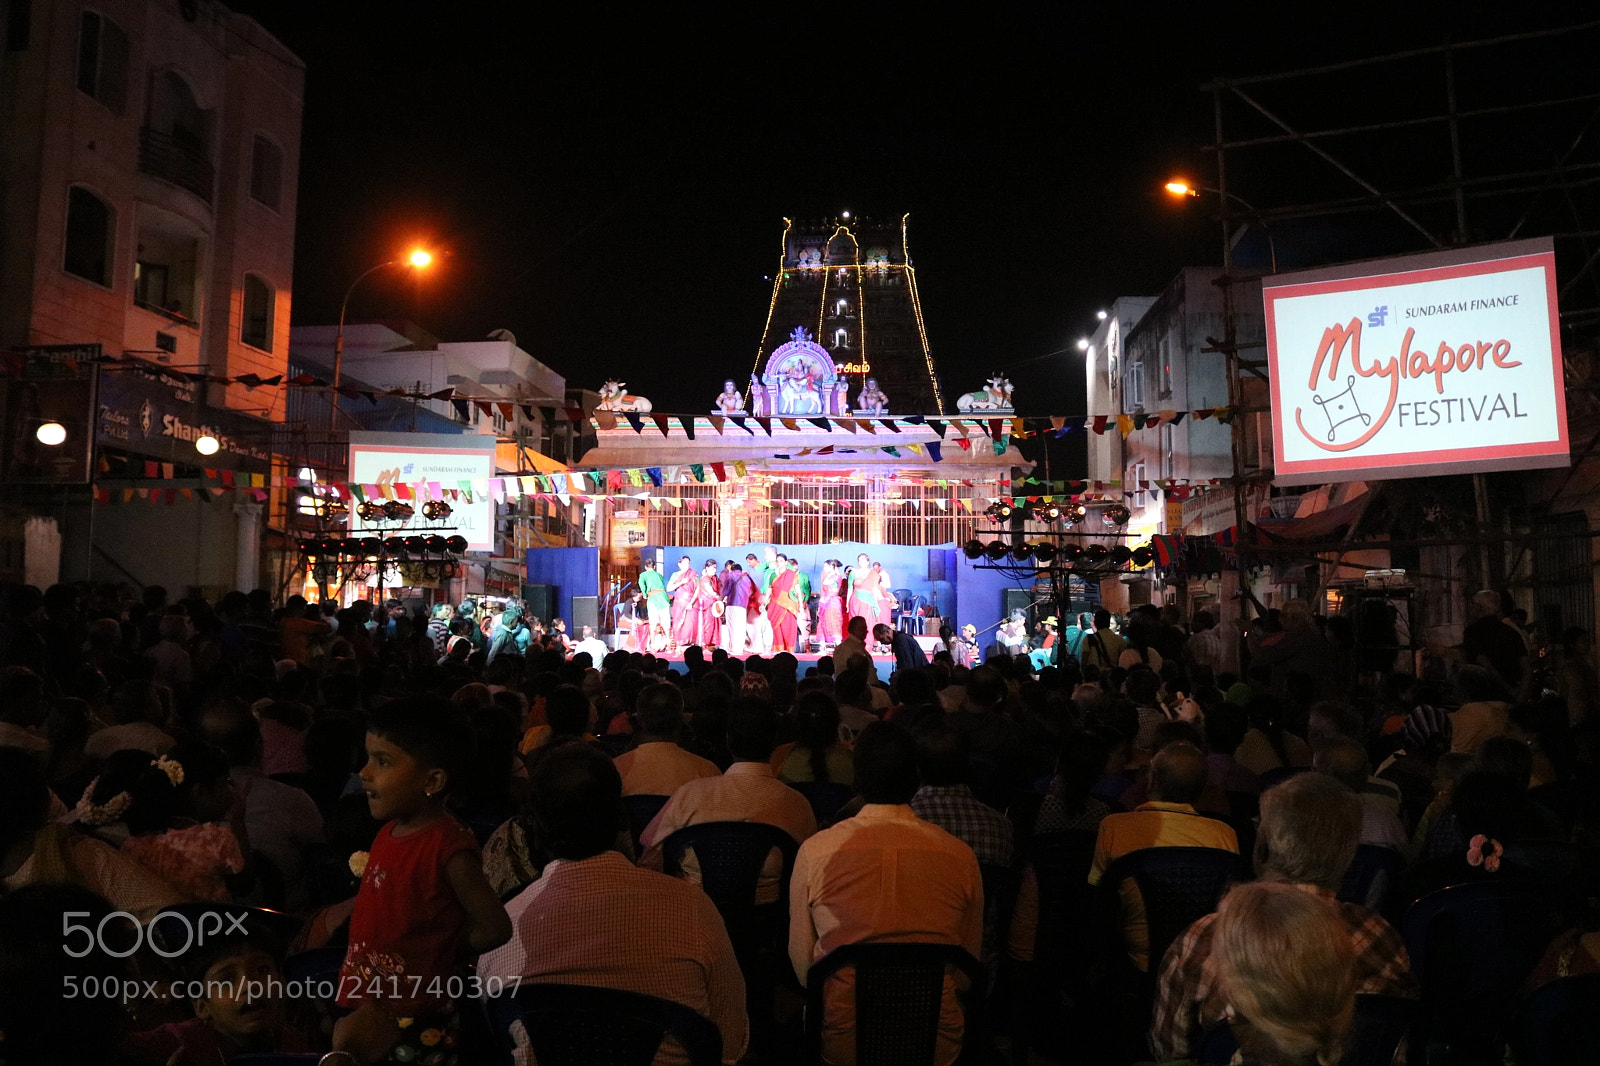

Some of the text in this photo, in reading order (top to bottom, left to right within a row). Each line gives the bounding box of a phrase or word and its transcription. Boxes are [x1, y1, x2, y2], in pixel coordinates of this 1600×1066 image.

[1405, 294, 1519, 319] SUNDARAM FINANCE
[1296, 316, 1522, 452] Mylapore
[1398, 392, 1528, 427] FESTIVAL
[414, 515, 475, 530] FSTVAL
